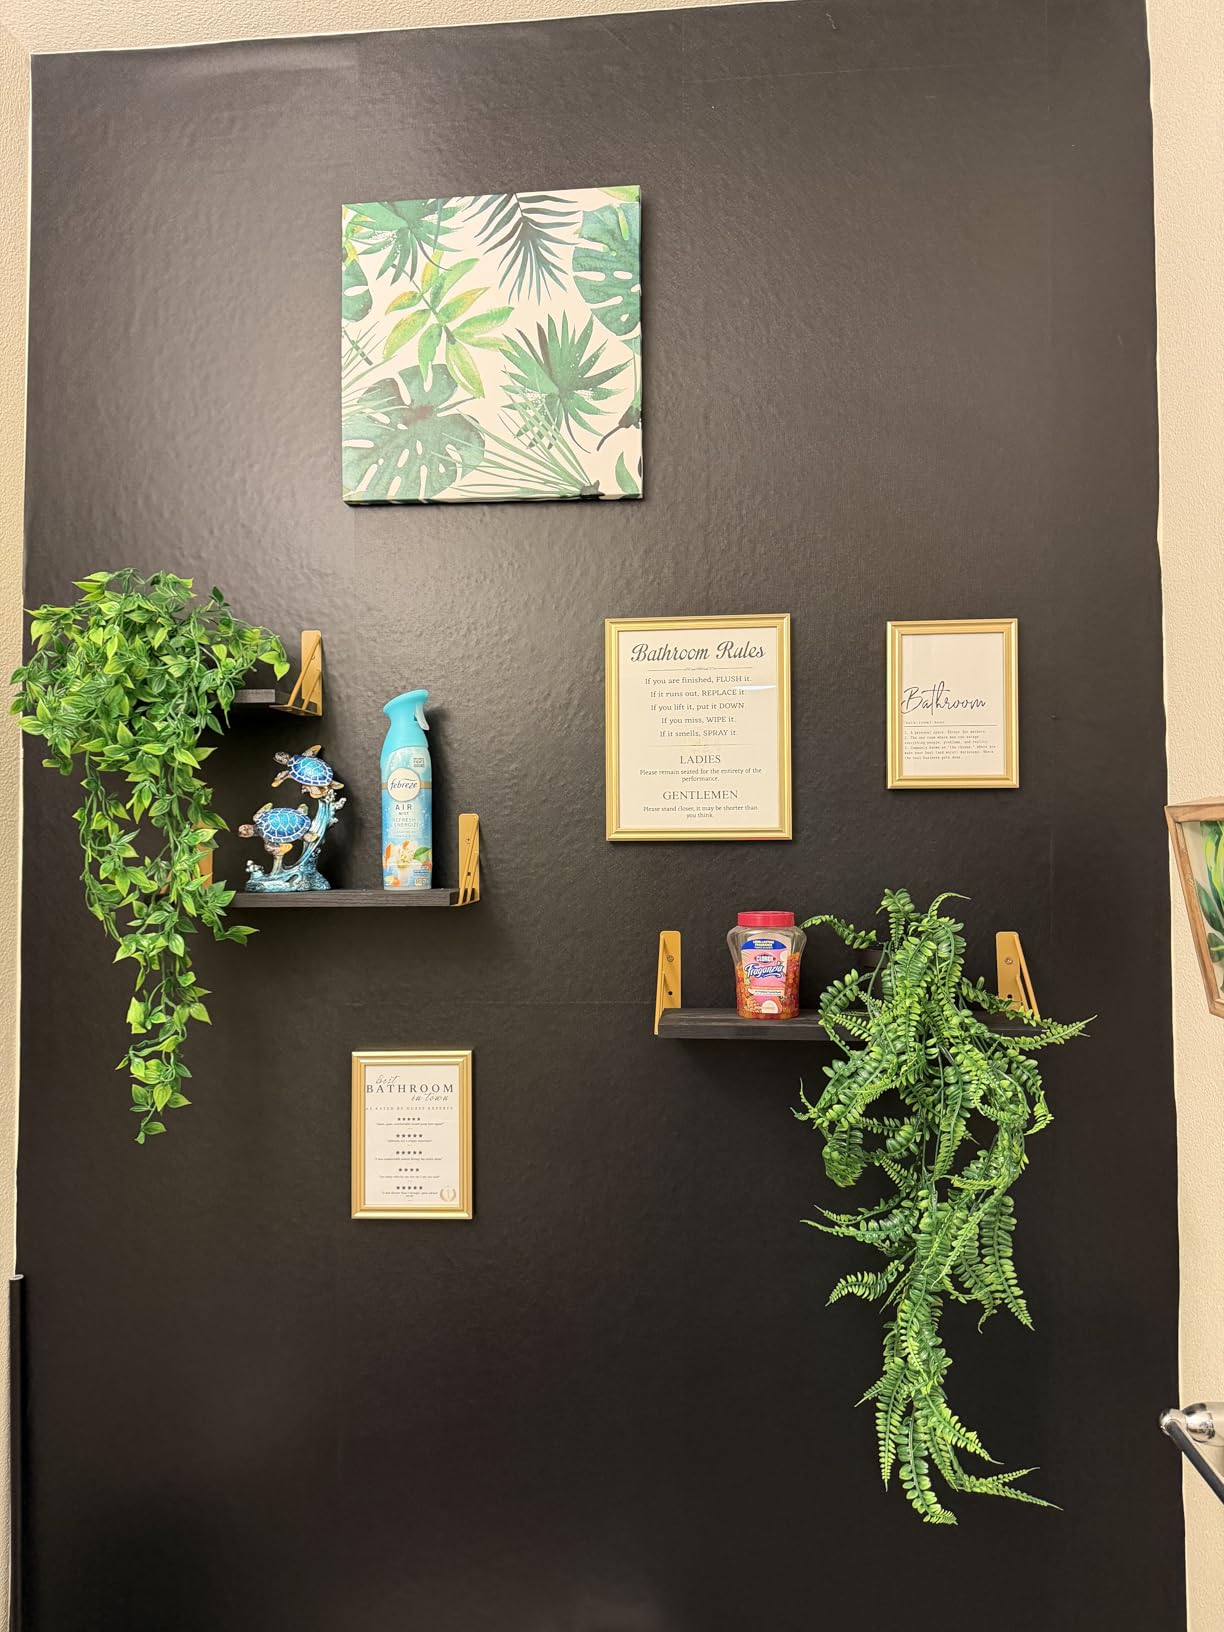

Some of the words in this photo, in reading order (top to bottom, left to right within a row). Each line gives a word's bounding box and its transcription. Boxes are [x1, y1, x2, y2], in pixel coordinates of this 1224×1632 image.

[631, 643, 710, 662] Bathroom
[716, 641, 766, 660] Rules
[682, 676, 714, 684] finished,
[702, 689, 737, 697] REPLACE
[900, 681, 986, 716] Bathroom
[680, 755, 721, 765] LADIES
[390, 778, 417, 790] febreze
[662, 790, 738, 801] GENTLEMEN
[367, 1084, 454, 1094] BATHROOM
